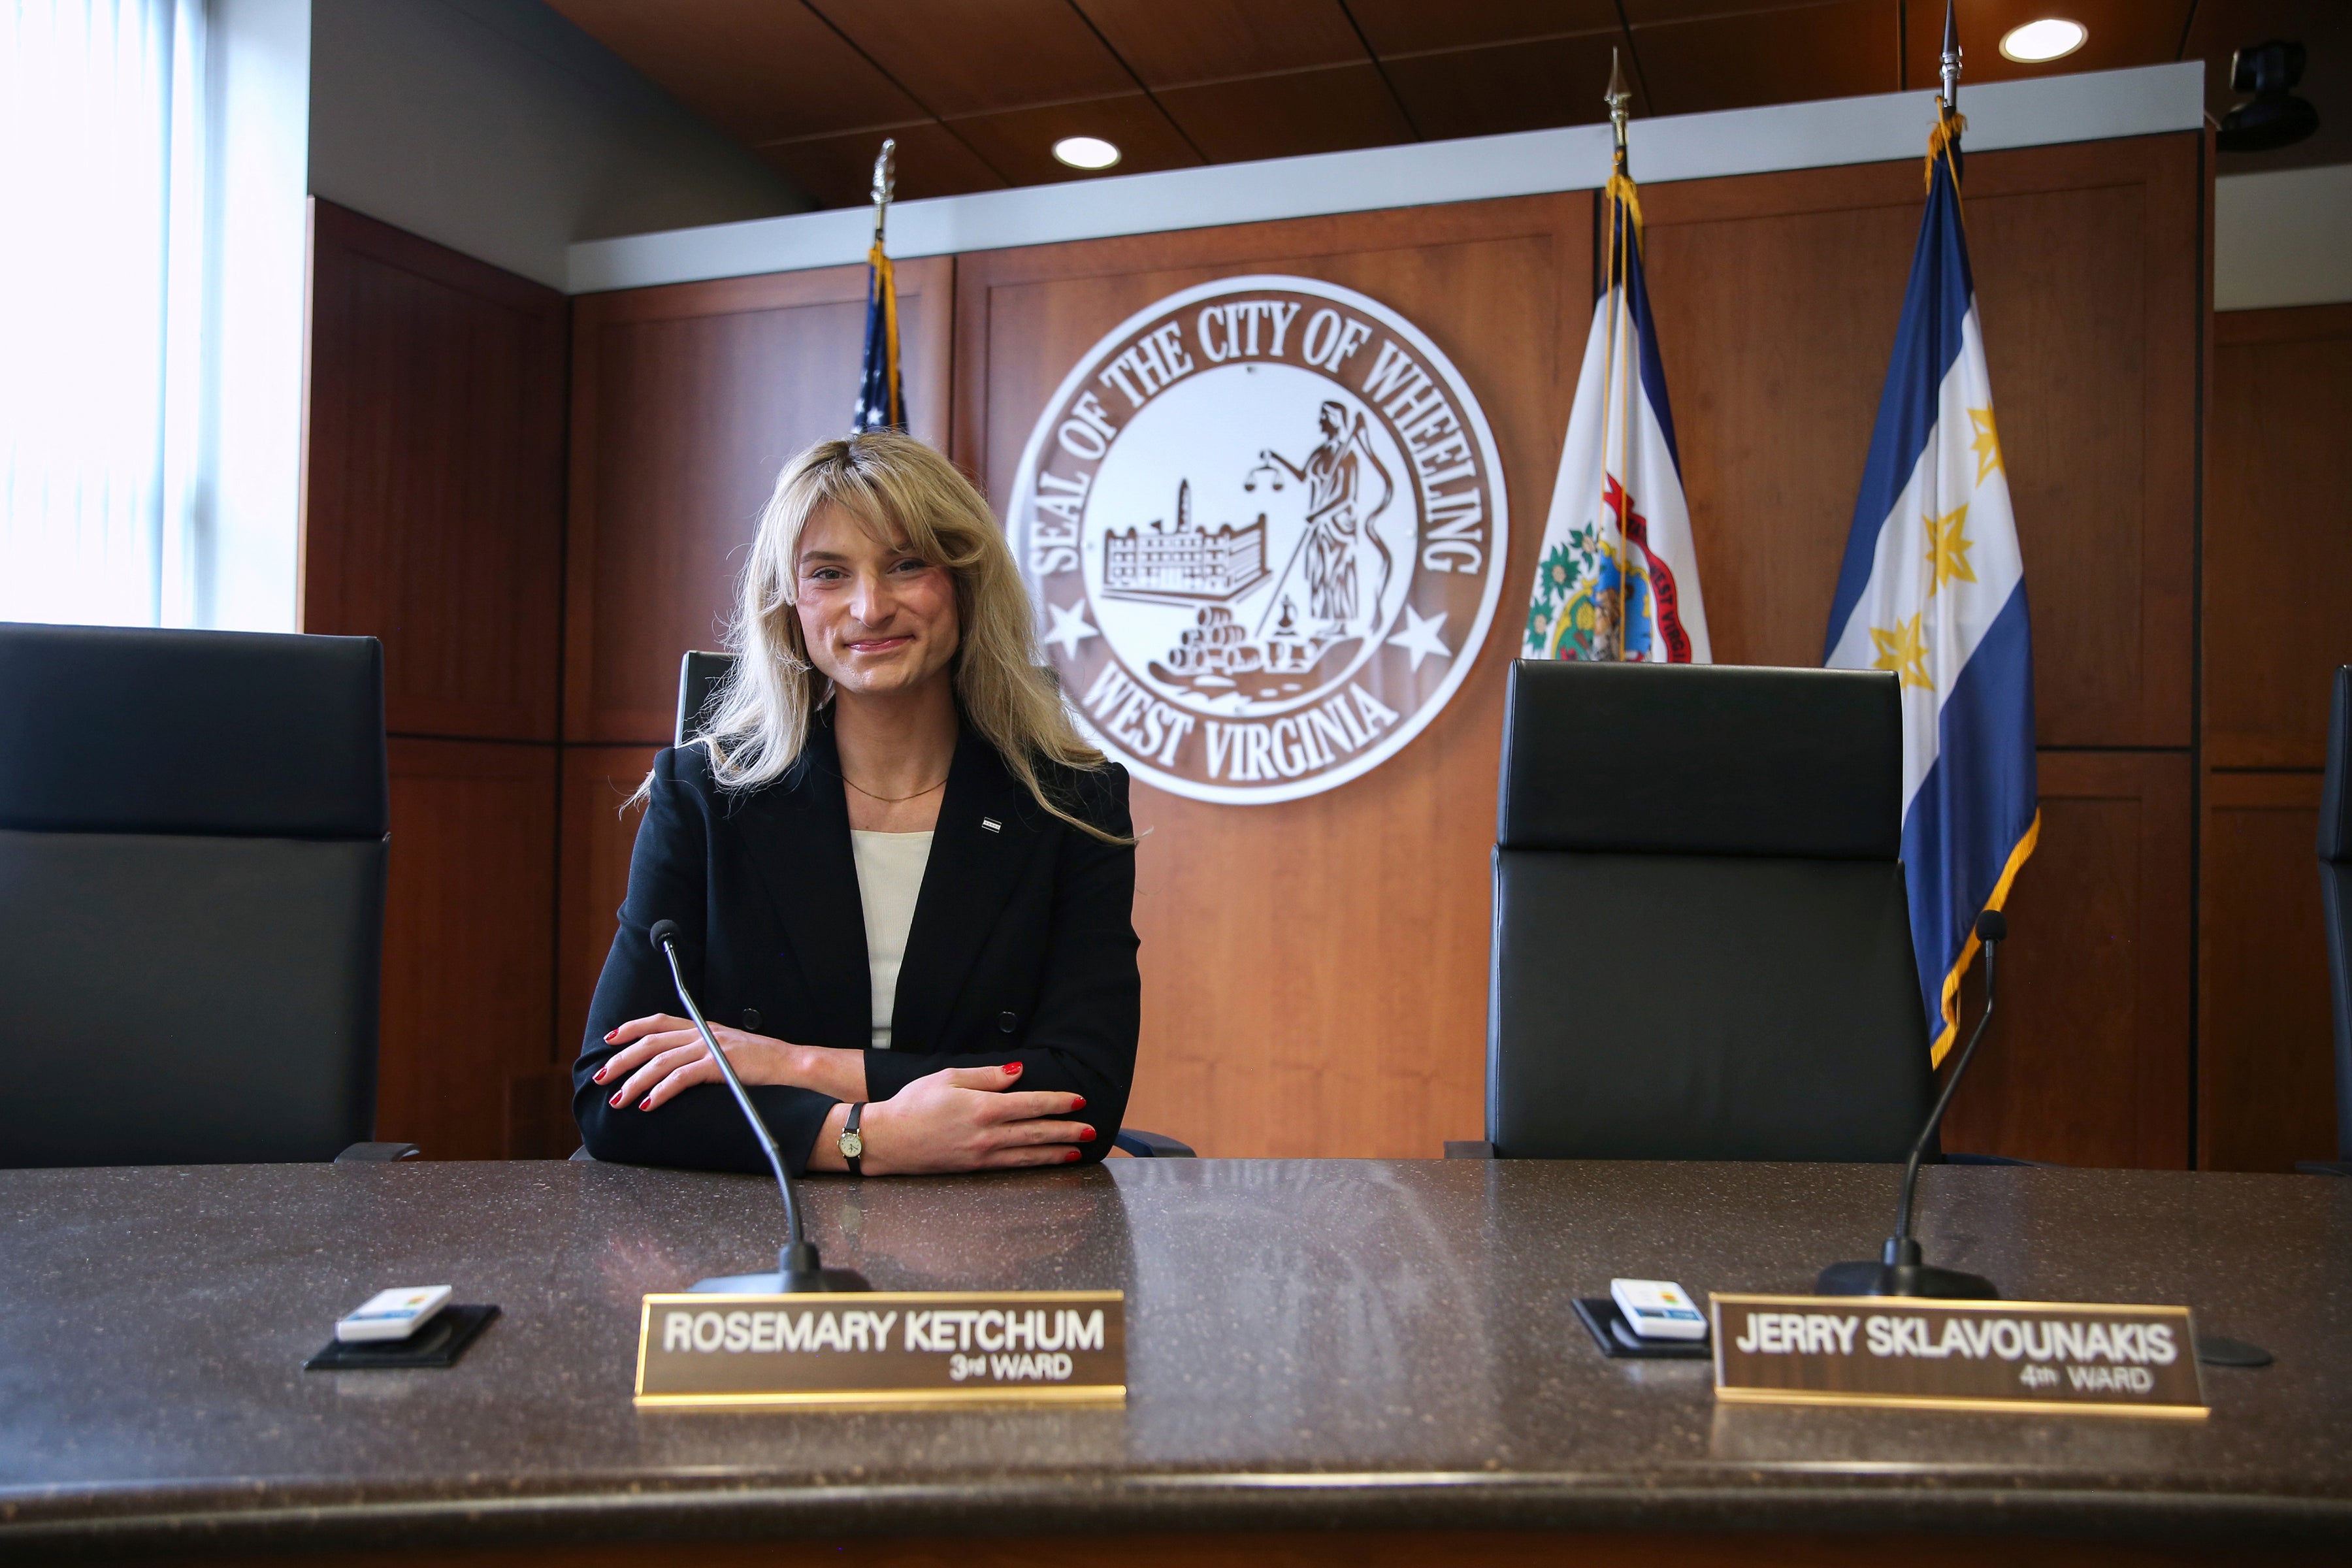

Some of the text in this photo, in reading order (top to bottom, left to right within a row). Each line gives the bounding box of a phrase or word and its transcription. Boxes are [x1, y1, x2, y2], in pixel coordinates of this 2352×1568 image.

[1030, 301, 1484, 575] SEAL OF THE CITY OF WHEELING
[1084, 660, 1399, 782] WEST VIRGINIA
[663, 1309, 1104, 1353] ROSEMARY KETCHUM
[1736, 1314, 2175, 1364] JERRY SKLAVOUNAKIS
[950, 1354, 1073, 1381] 3rd WARD
[2019, 1364, 2154, 1393] 4th WARD
